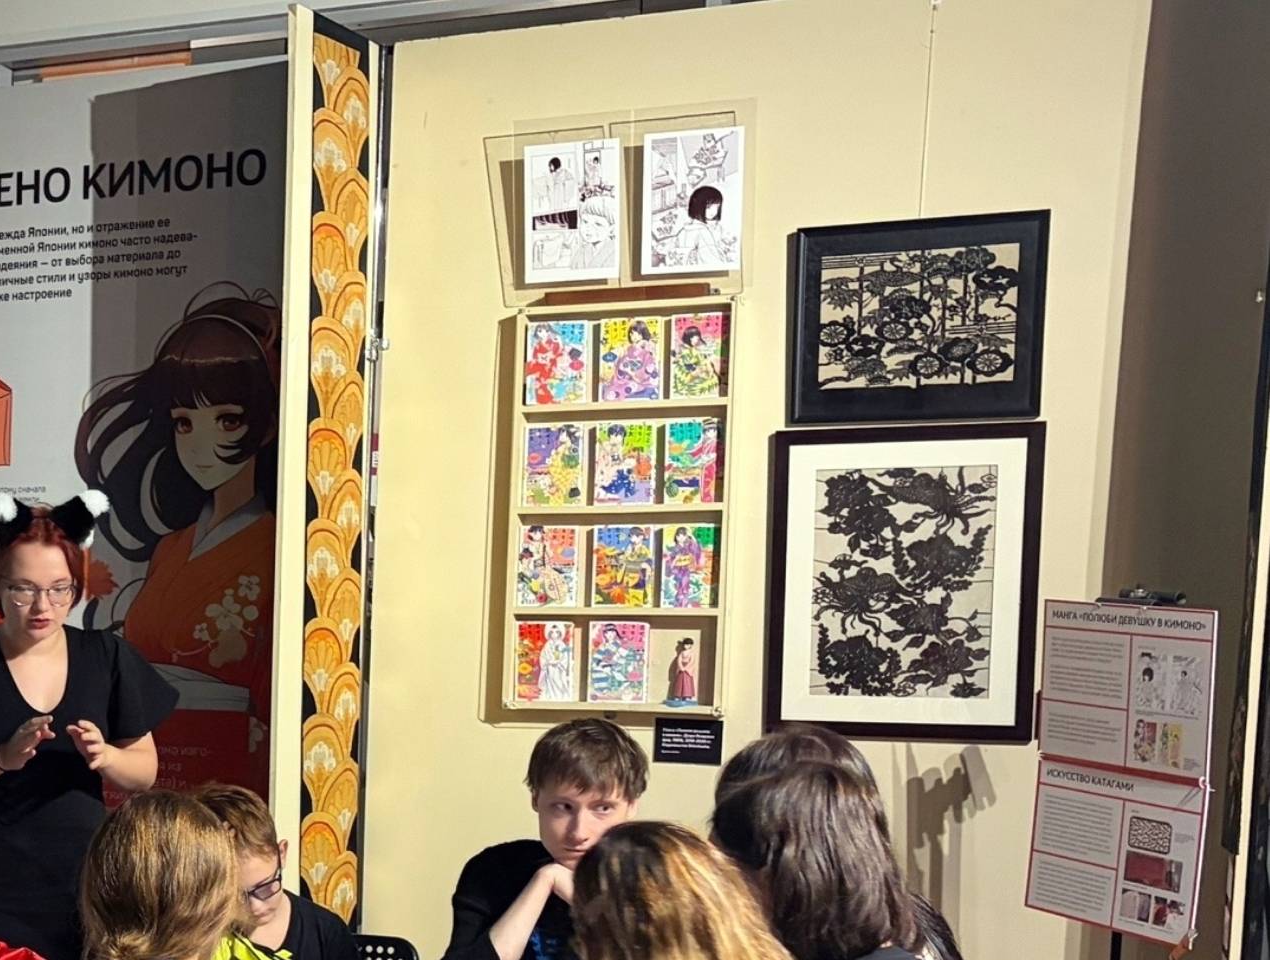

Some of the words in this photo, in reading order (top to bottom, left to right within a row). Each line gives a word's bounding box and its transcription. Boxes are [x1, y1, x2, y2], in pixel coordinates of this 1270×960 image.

[83, 148, 267, 200] КИМОНО
[28, 226, 70, 238] Японии,
[71, 225, 85, 234] но
[87, 224, 94, 232] и
[96, 220, 155, 234] отражение
[157, 218, 171, 227] ее
[37, 240, 76, 252] Японии
[78, 238, 118, 249] кимоно
[121, 236, 151, 247] часто
[153, 232, 198, 244] надева-
[51, 258, 62, 267] от
[65, 253, 105, 268] выбора
[107, 250, 164, 265] материала
[167, 249, 181, 260] до
[36, 273, 66, 283] стили
[69, 272, 75, 281] и
[78, 270, 112, 284] узоры
[114, 267, 154, 278] кимоно
[156, 264, 188, 278] могут
[12, 288, 73, 302] настроение
[1052, 610, 1078, 620] МАНГА
[1079, 612, 1117, 624] «ПОЛЮБИ
[1118, 615, 1156, 627] ДЕВУШКУ
[1157, 618, 1163, 628] В
[1164, 619, 1207, 631] КИМОНО»
[1046, 768, 1090, 784] ИСКУССТВО
[1091, 776, 1135, 791] КАТАГАМИ
